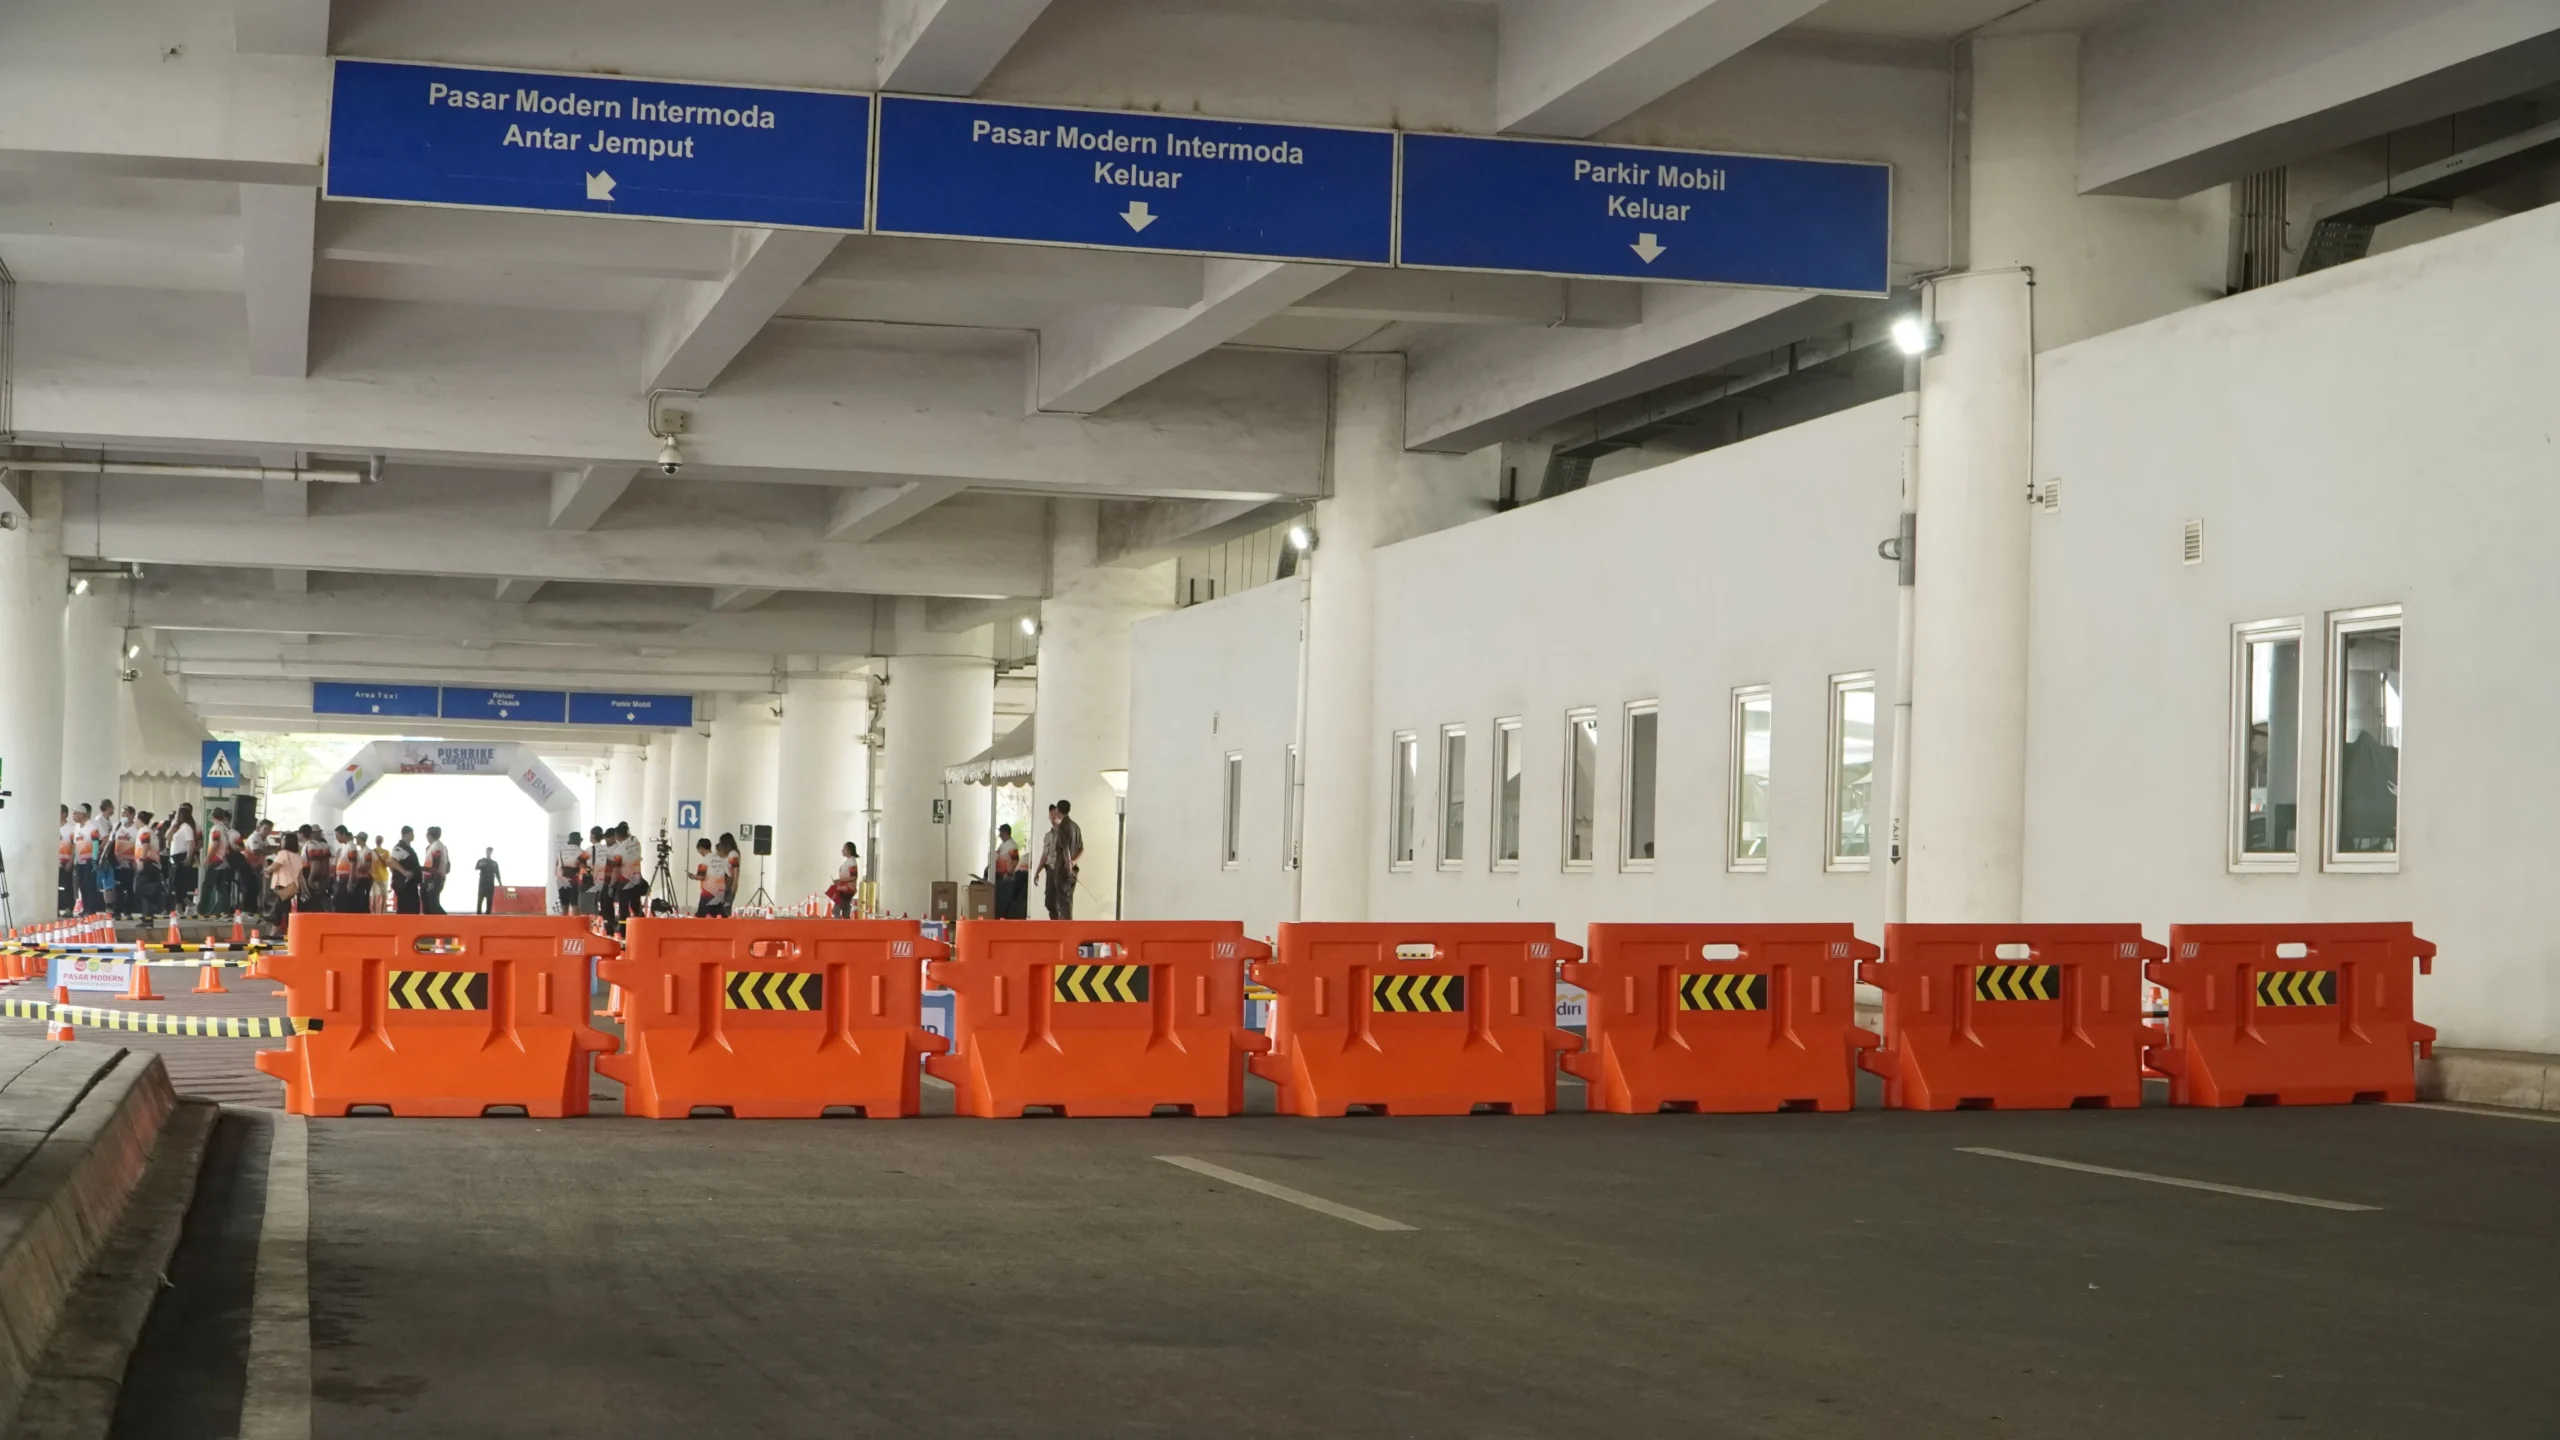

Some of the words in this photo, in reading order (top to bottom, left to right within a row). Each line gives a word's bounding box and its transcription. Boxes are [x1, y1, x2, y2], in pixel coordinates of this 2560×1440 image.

[429, 82, 510, 111] Pasar
[516, 89, 621, 119] Modern
[632, 97, 775, 129] Intermoda
[503, 124, 582, 152] Antar
[589, 129, 694, 162] Jemput
[973, 119, 1051, 148] Pasar
[1057, 125, 1158, 155] Modern
[1168, 133, 1304, 166] Intermoda
[1094, 161, 1183, 190] Keluar
[1574, 159, 1651, 186] Parkir
[1658, 164, 1726, 192] Mobil
[1608, 194, 1691, 222] Keluar
[355, 691, 376, 699] Area
[377, 691, 398, 700] Taxi
[492, 692, 515, 700] Keluar
[611, 700, 632, 708] Parkir
[632, 701, 651, 709] Mobil
[437, 748, 495, 759] PUSHBIKE
[531, 776, 554, 800] BNI
[63, 972, 89, 981] PASAR
[90, 973, 124, 982] MODERN
[1556, 1002, 1581, 1015] diri
